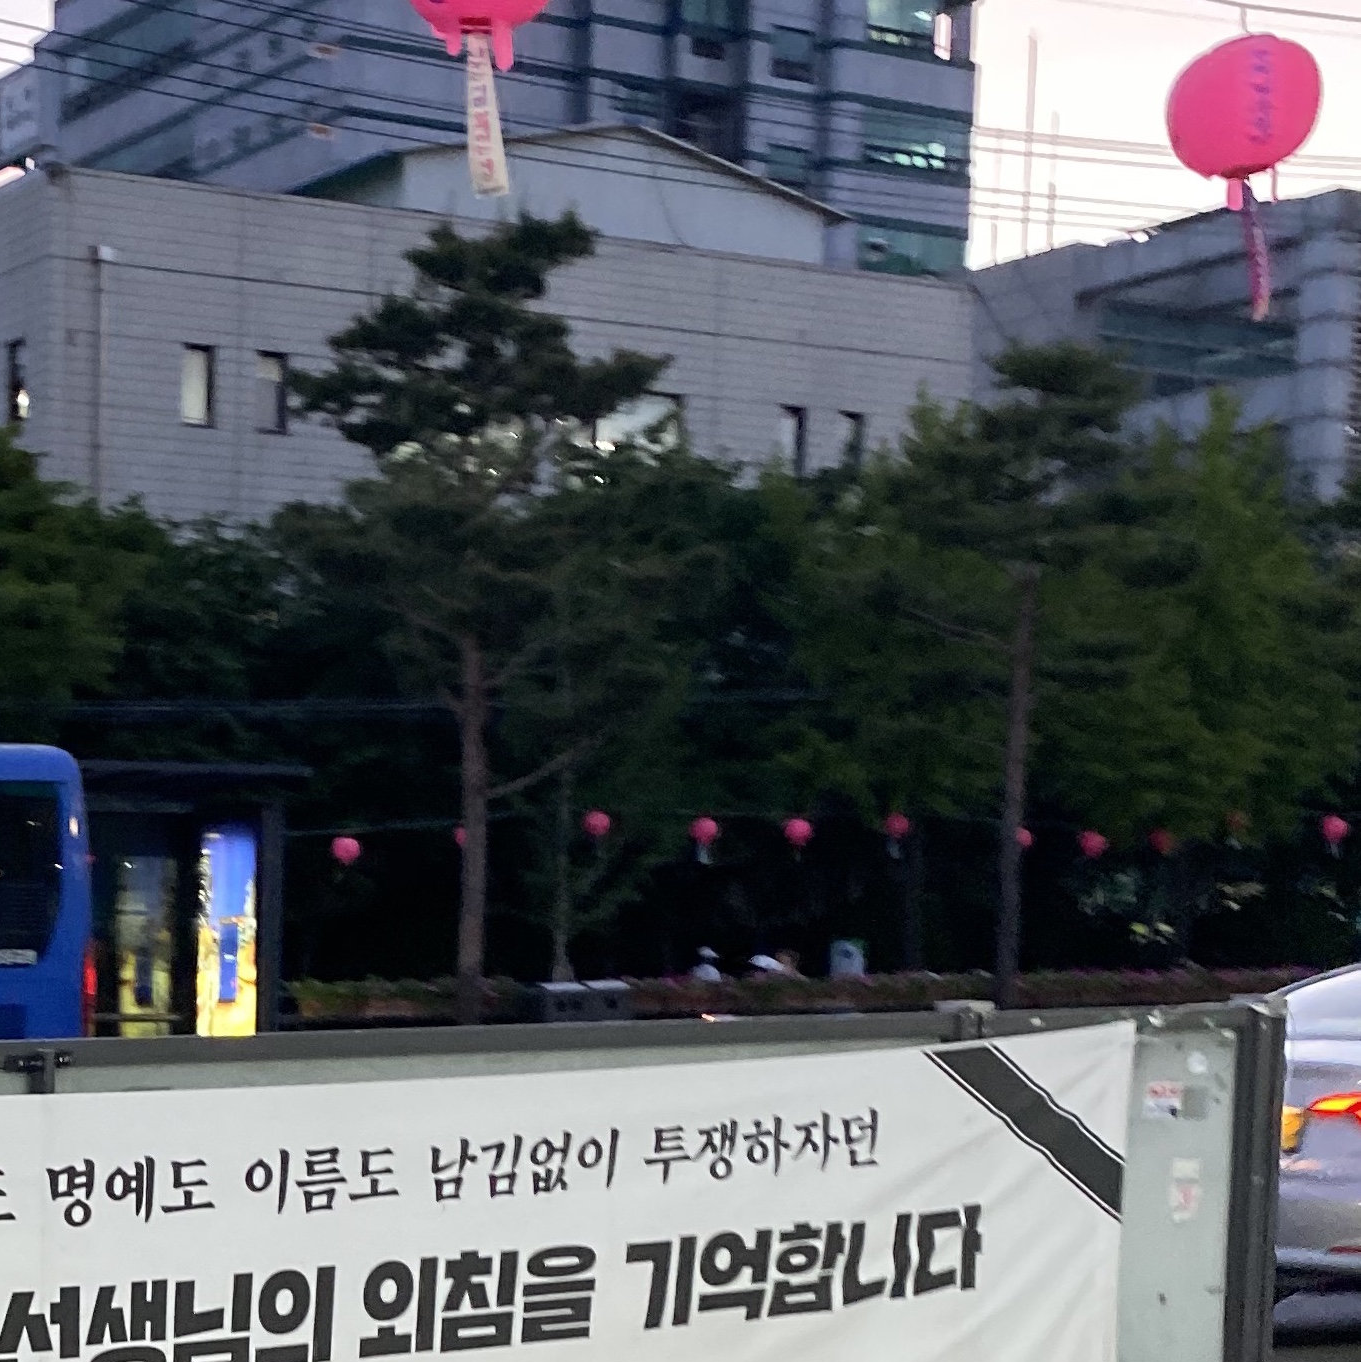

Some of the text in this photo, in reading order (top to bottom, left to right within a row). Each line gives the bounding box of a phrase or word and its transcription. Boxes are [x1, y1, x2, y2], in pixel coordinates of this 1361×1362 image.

[45, 1156, 216, 1228] 명예도
[244, 1147, 400, 1215] 이름도
[430, 1127, 620, 1203] 남김없이
[643, 1107, 878, 1185] 투쟁하자던
[358, 1245, 597, 1359] 외침을
[625, 1204, 982, 1331] 기억합니다
